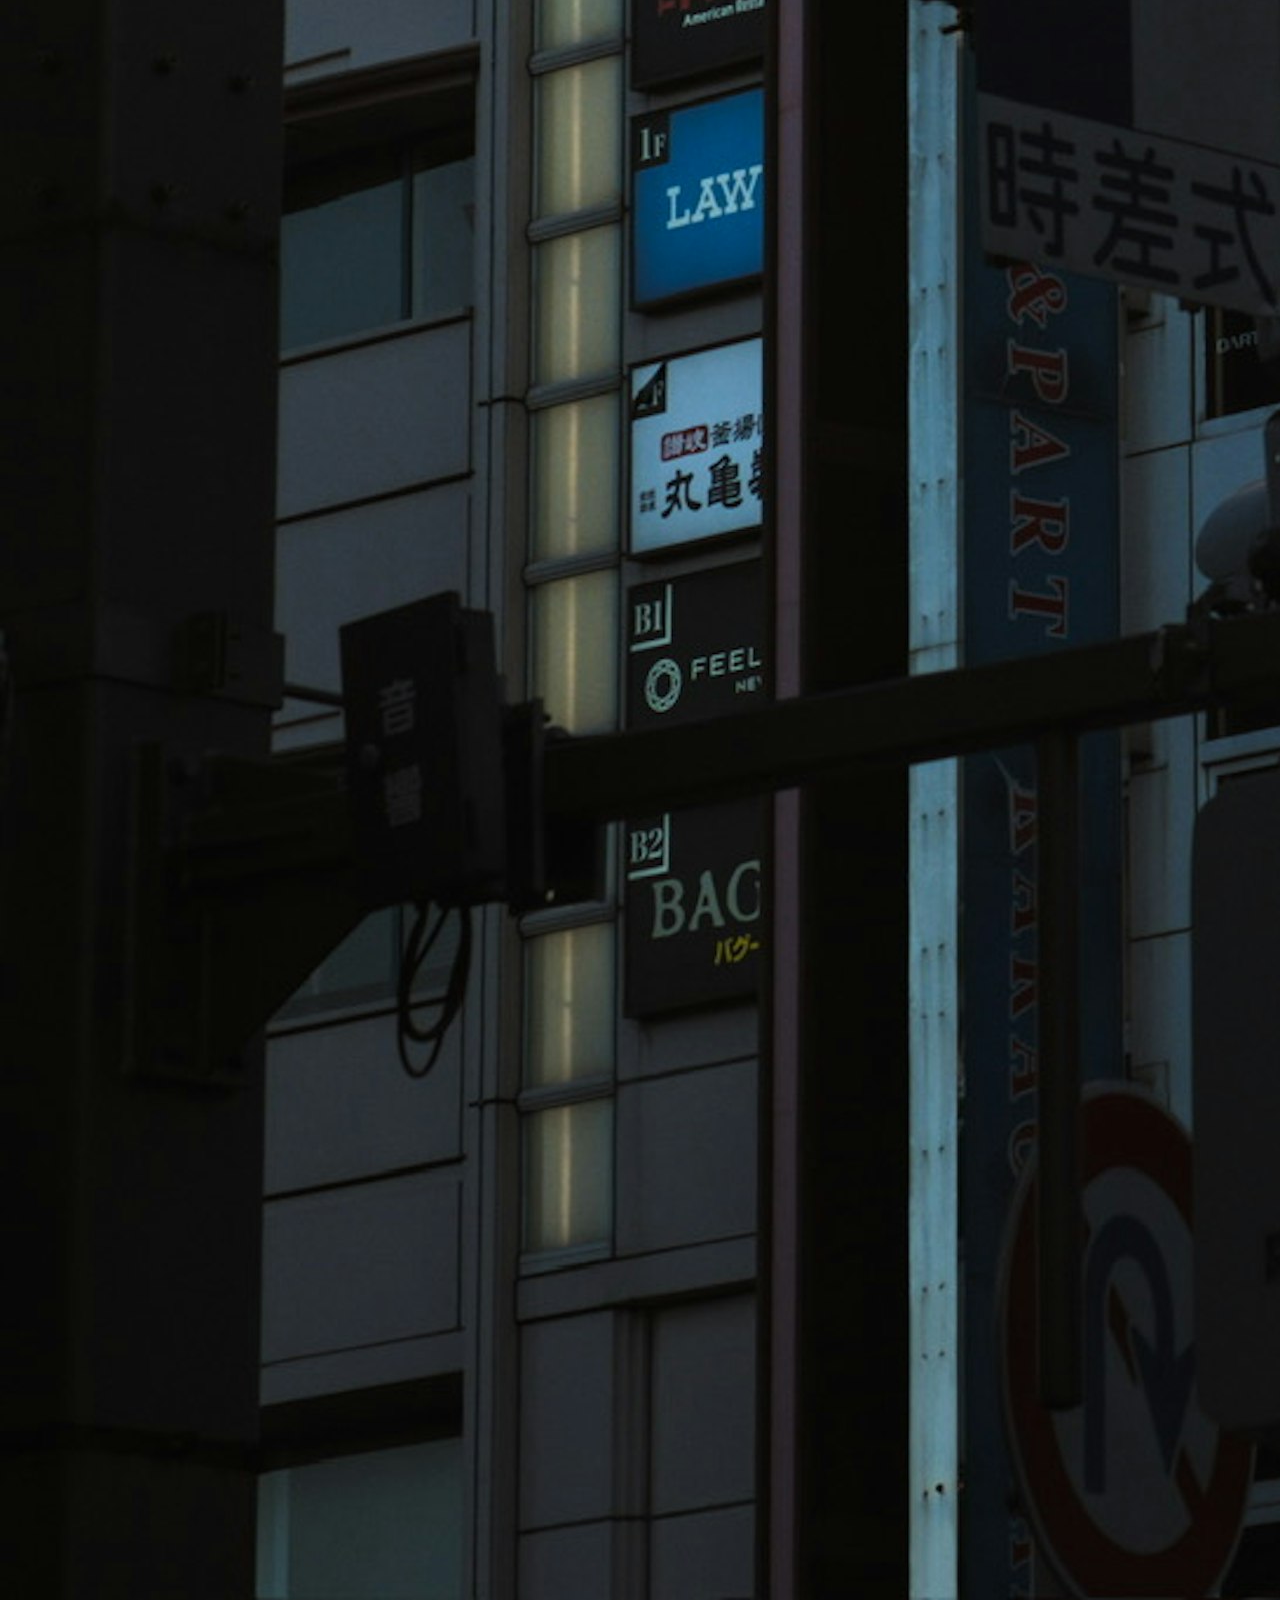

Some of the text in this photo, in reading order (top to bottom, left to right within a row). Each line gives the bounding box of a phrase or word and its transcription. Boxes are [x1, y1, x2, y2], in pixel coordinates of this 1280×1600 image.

[640, 127, 667, 162] 1F
[665, 163, 764, 231] LAW
[986, 121, 1277, 308] 時差式
[633, 599, 663, 636] B1
[689, 646, 763, 681] FEEL
[629, 825, 664, 865] B2
[650, 858, 762, 940] BAG
